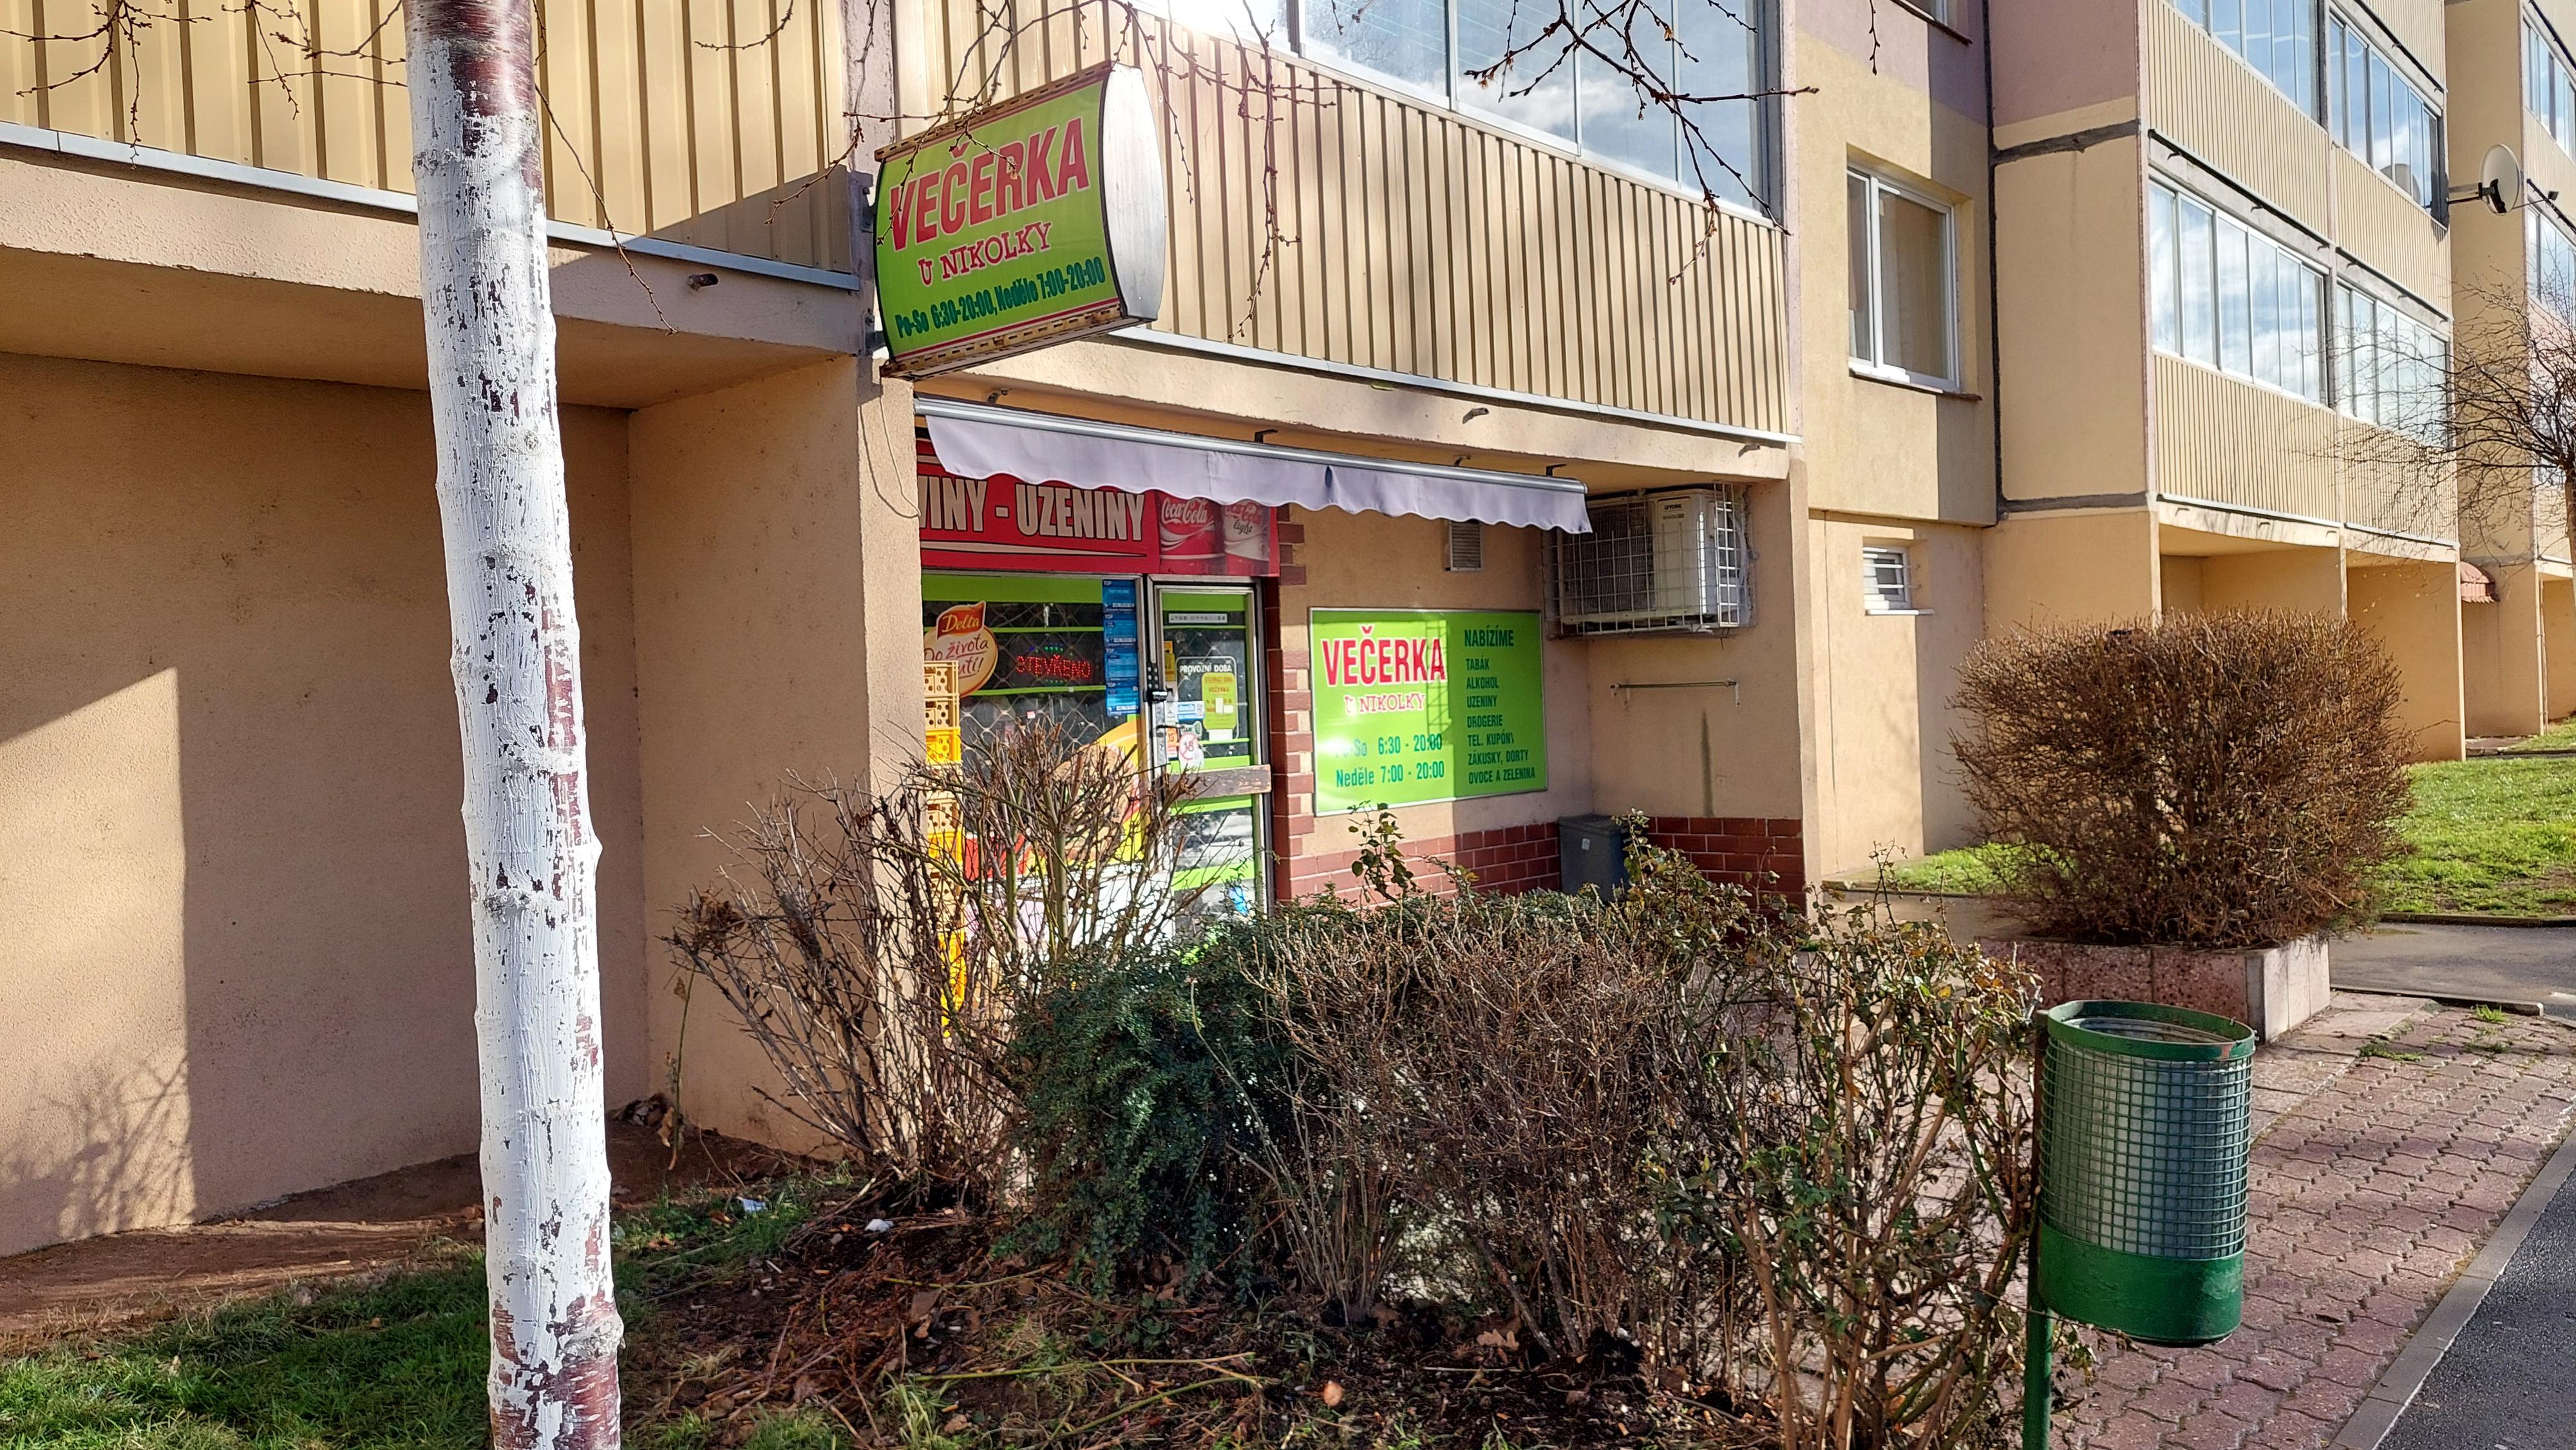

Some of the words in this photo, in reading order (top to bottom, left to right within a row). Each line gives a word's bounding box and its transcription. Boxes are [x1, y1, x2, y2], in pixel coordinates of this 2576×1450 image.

[891, 117, 1090, 250] VEČERKA
[918, 258, 933, 286] U
[940, 221, 1052, 279] NIKOLKY
[895, 310, 929, 338] Po-So
[931, 289, 998, 329] 6:30-20:00,
[994, 278, 1039, 311] Neděle
[1036, 256, 1106, 299] 7:00-20:00
[1015, 484, 1145, 541] UZENINY
[1161, 497, 1208, 524] Coca-Cola
[942, 614, 980, 632] Delta
[1464, 625, 1514, 647] NABÍZÍME
[946, 634, 990, 659] života
[1322, 626, 1446, 686] VEČERKA
[1466, 655, 1490, 670] TABÁK
[1179, 663, 1212, 673] PROVOZNÍ
[1214, 664, 1233, 672] DOBA
[1466, 677, 1499, 689] ALKOHOL
[1359, 693, 1425, 712] NIKOLKY
[1467, 695, 1497, 708] UZENINY
[1467, 715, 1503, 728] DROGERIE
[1378, 737, 1401, 755] 6:30
[1468, 735, 1483, 746] TEL.
[1468, 749, 1503, 765] ZÁKUSKY,
[1506, 749, 1529, 762] DORTY
[1336, 767, 1374, 787] Neděle
[1380, 764, 1403, 783] 7:00
[1416, 760, 1445, 780] 20:00
[1468, 771, 1493, 784] OVOCE
[1496, 769, 1501, 782] A
[1503, 766, 1535, 781] ZELENINA
